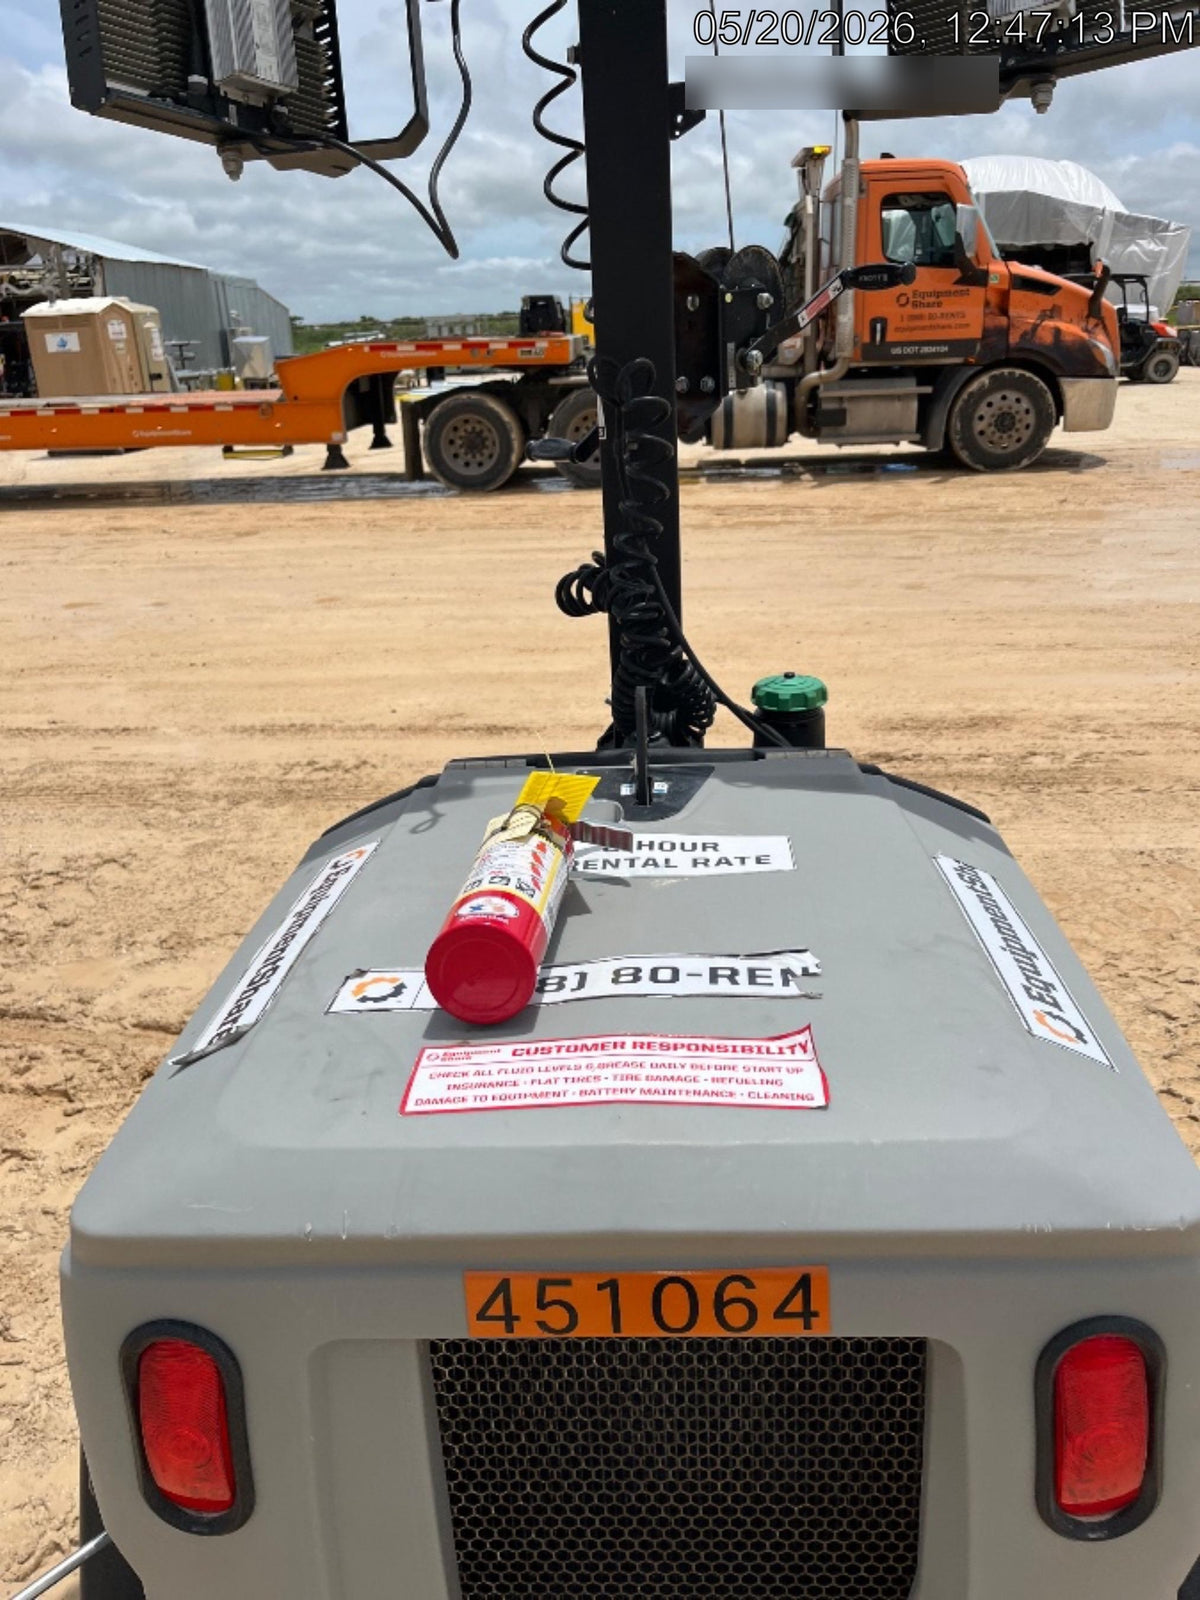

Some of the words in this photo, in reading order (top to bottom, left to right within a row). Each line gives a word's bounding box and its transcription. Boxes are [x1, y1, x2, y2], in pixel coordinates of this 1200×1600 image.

[911, 288, 970, 299] Equipment
[911, 300, 943, 309] Share
[903, 346, 919, 354] DOT
[636, 840, 720, 853] HOUR
[691, 855, 772, 868] RATE
[511, 1041, 626, 1057] CUSTOMER
[632, 1039, 809, 1055] RESPONSIBILITY
[428, 1070, 470, 1080] CHECK
[497, 1066, 534, 1075] FLUID
[538, 1064, 582, 1072] LEVELS
[690, 1063, 739, 1071] BEFORE
[742, 1065, 783, 1073] START
[447, 1080, 520, 1091] INSURANCE
[530, 1077, 560, 1085] FLAT
[563, 1075, 602, 1084] TIRES
[613, 1073, 641, 1081] TIRE
[645, 1074, 700, 1083] DAMAGE
[710, 1077, 784, 1086] REFUELING
[414, 1096, 468, 1106] DAMAGE
[473, 1094, 488, 1102] TO
[491, 1089, 569, 1102] EQUIPMENT
[579, 1087, 637, 1096] BATTERY
[639, 1087, 736, 1098] MAINTENANCE
[748, 1091, 815, 1101] CLEANING
[476, 1272, 820, 1335] 451064
